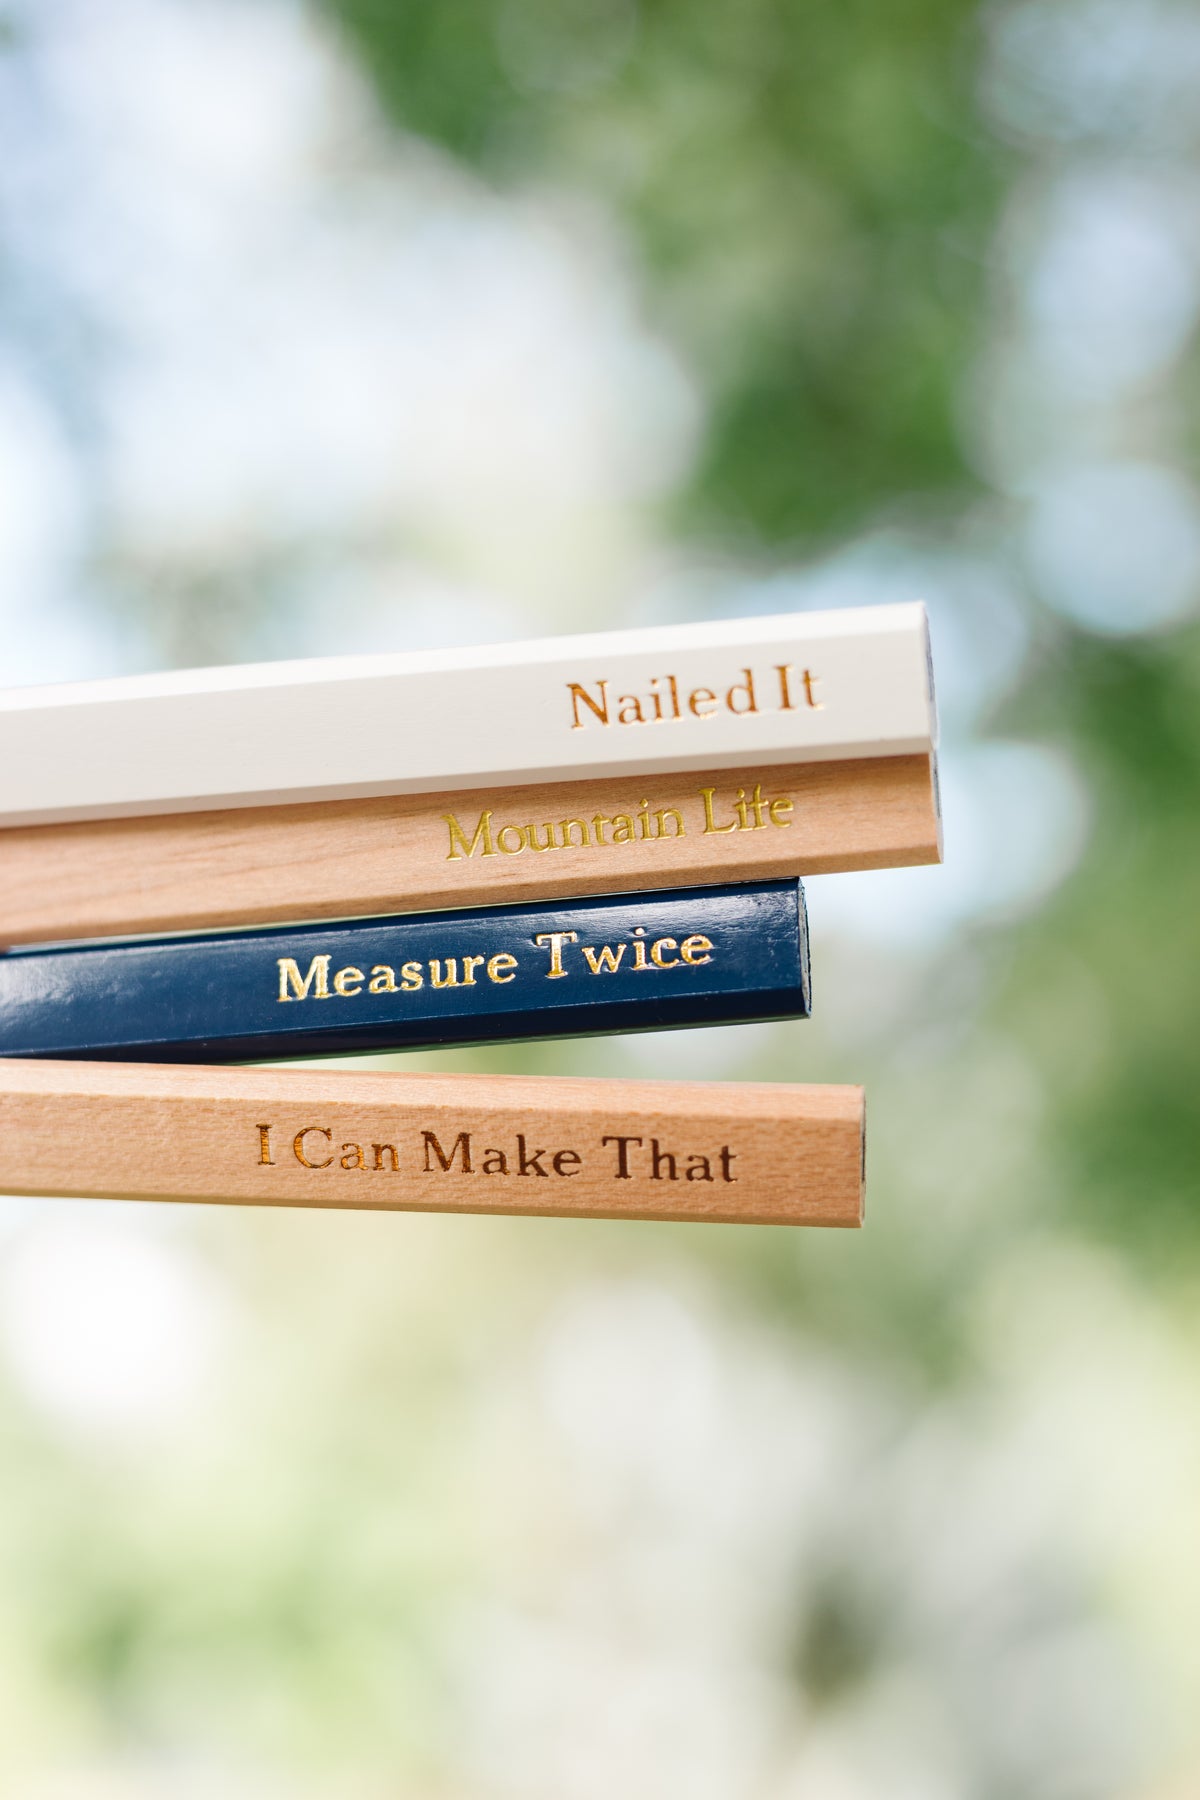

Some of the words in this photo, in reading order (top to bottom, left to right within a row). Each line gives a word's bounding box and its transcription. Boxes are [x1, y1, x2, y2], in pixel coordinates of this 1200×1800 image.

[566, 667, 759, 729] Nailed
[773, 664, 825, 711] It
[440, 799, 686, 861] Mountain
[698, 784, 795, 836] Life
[277, 952, 519, 1002] Measure
[535, 927, 715, 979] Twice
[255, 1123, 275, 1166] I
[293, 1125, 402, 1172] Can
[420, 1130, 582, 1177] Make
[601, 1134, 738, 1183] That
